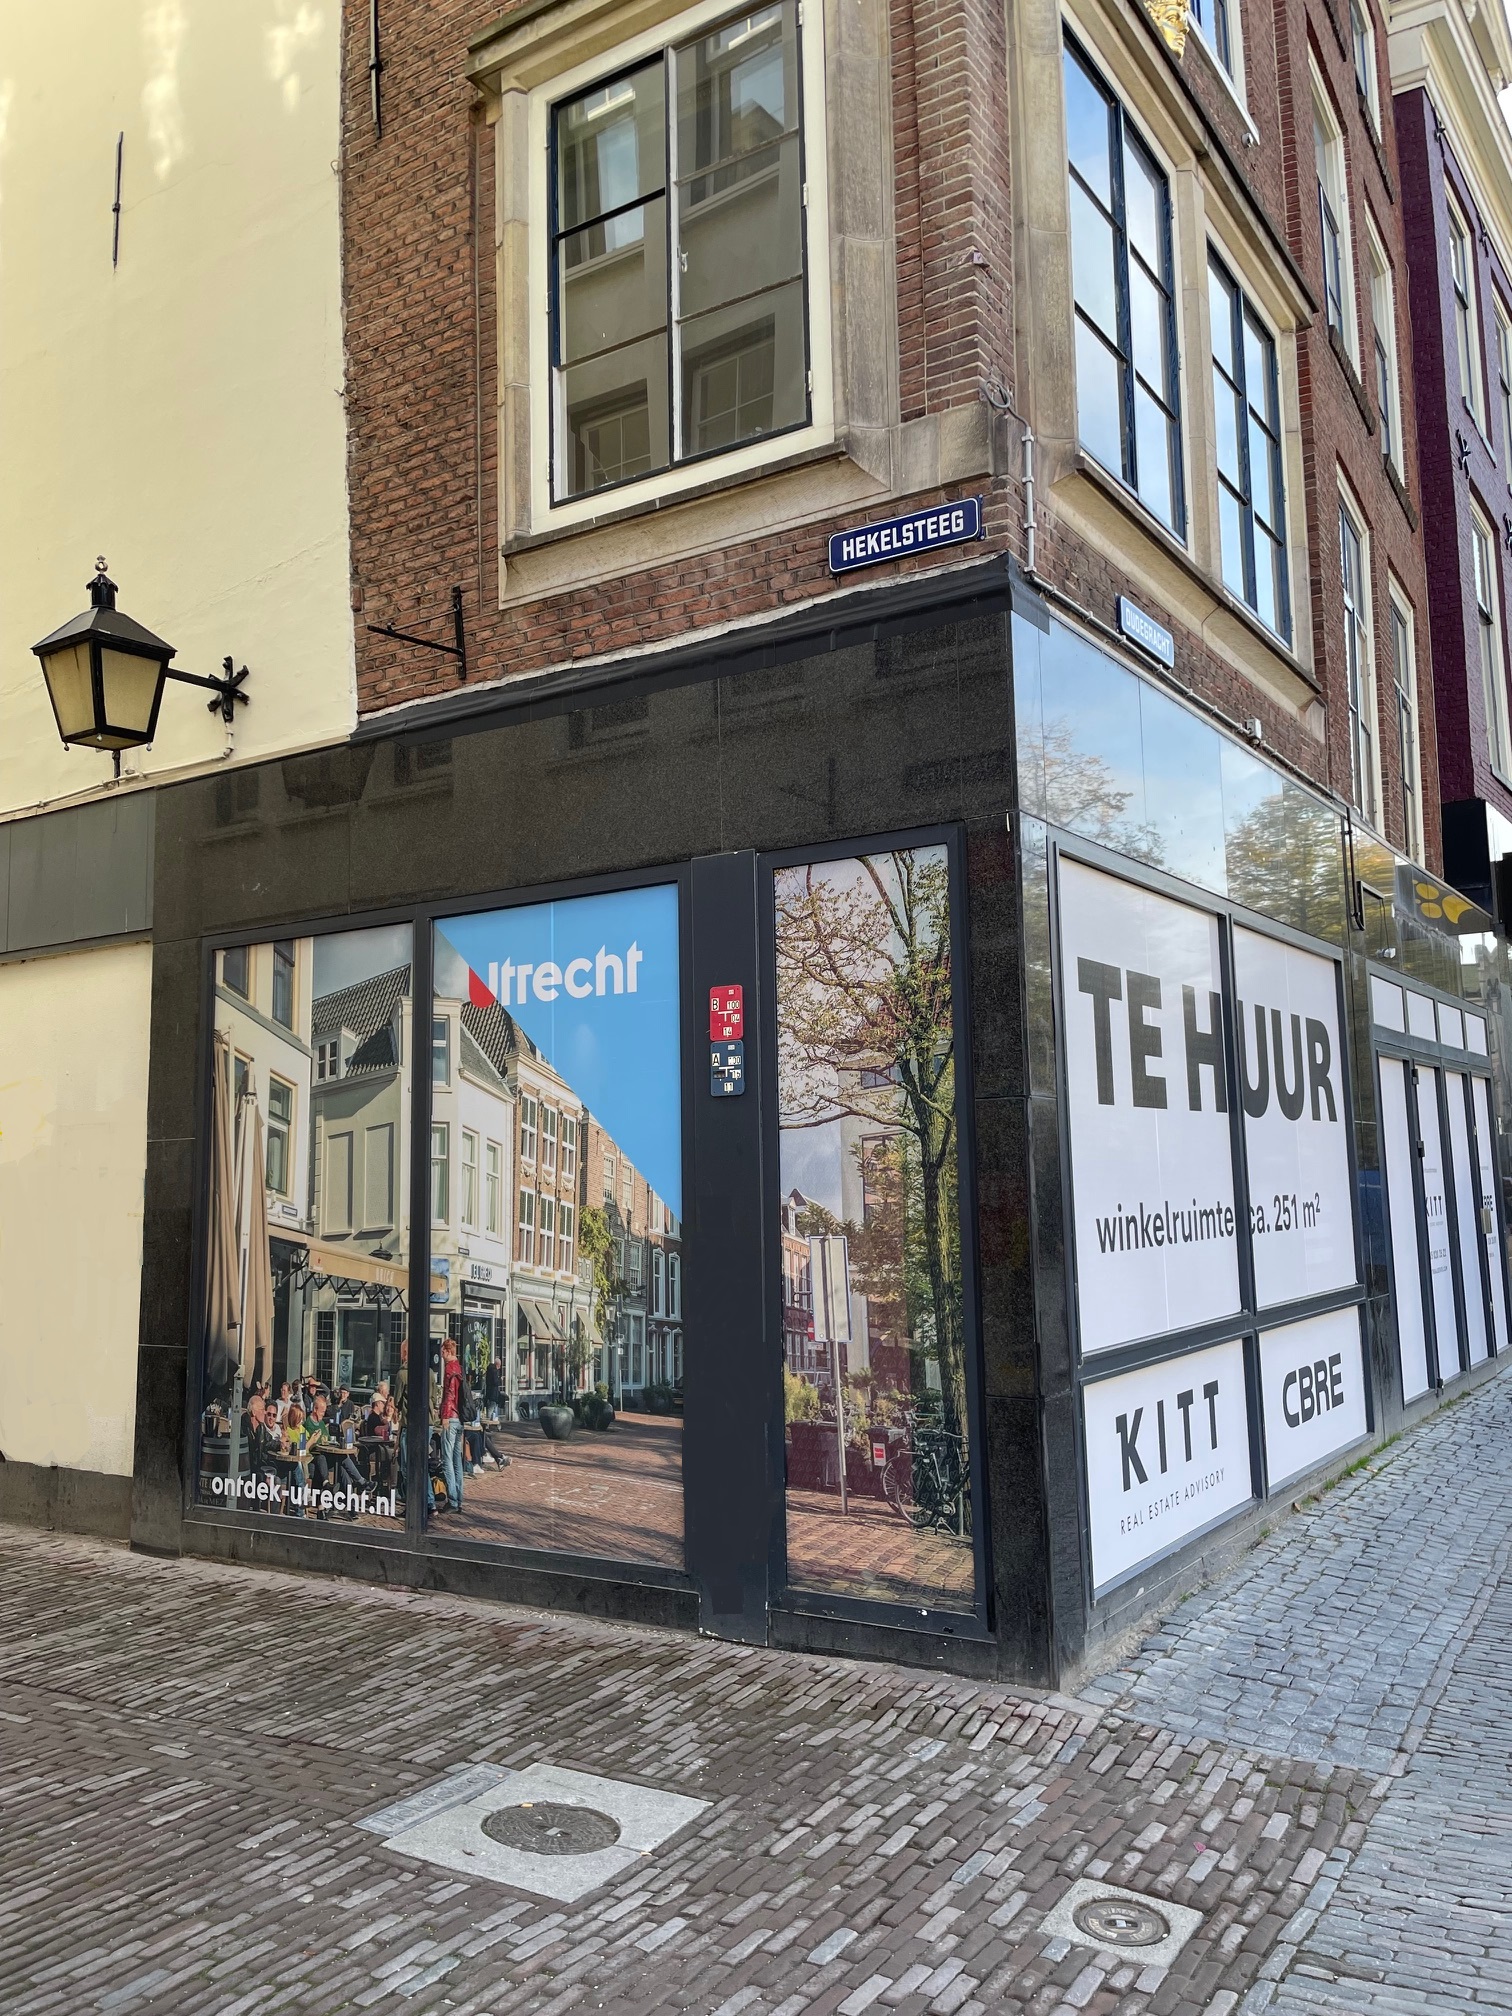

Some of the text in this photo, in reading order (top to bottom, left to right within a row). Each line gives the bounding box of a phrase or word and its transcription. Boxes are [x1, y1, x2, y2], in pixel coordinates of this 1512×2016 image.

[842, 509, 964, 561] HEKELSTEEG
[1125, 606, 1171, 657] OUDEGRACHT
[1077, 956, 1338, 1122] TE HUUR
[1096, 1198, 1235, 1254] winkelruimte
[1273, 1193, 1299, 1231] 251
[1282, 1352, 1345, 1429] CBRE
[1115, 1379, 1219, 1492] KITT
[211, 1473, 397, 1517] ontdek-utrecht.nl
[1120, 1467, 1225, 1536] REAL ESTATE ADVISORY
